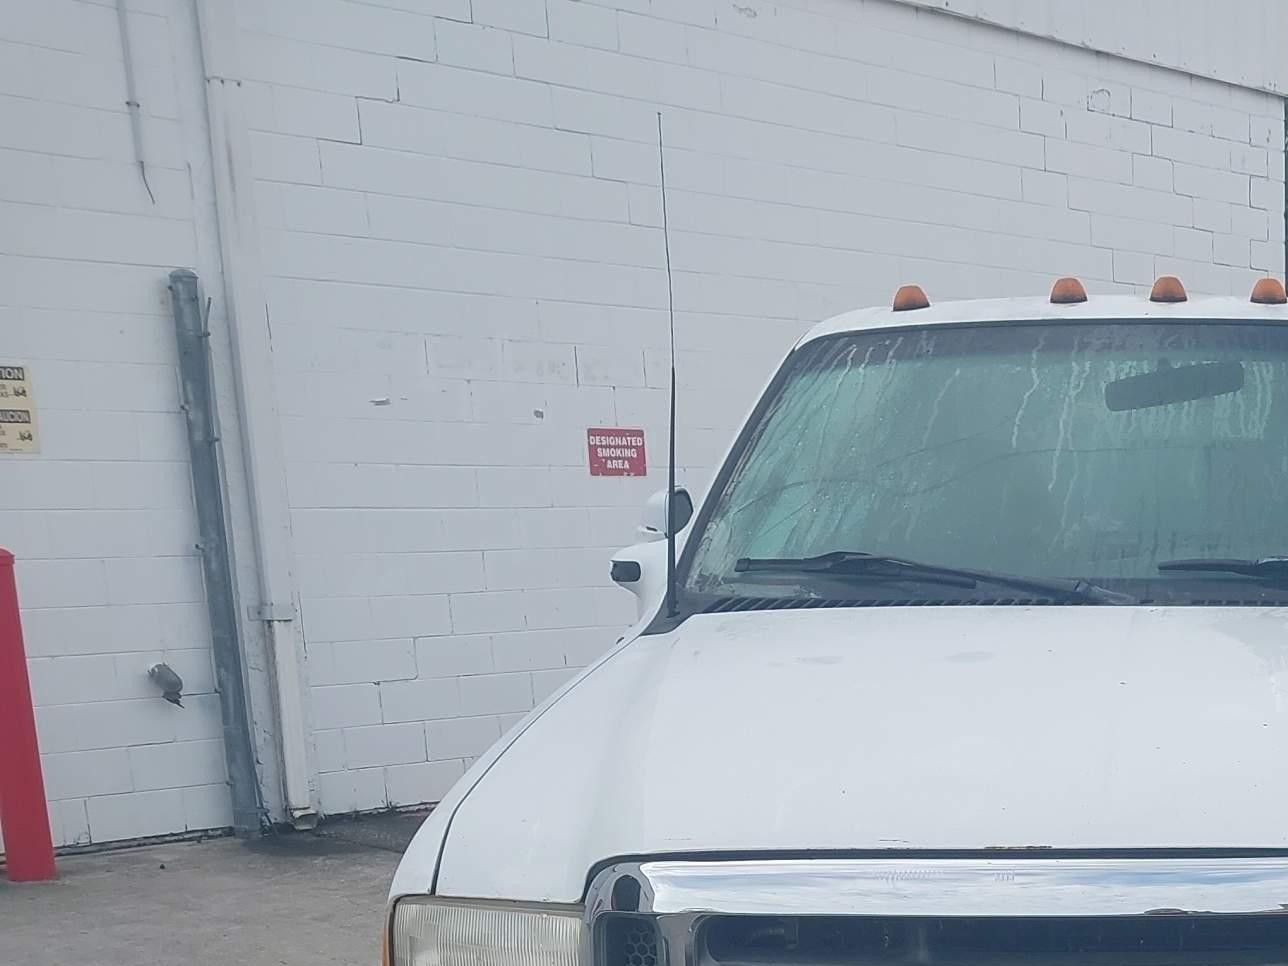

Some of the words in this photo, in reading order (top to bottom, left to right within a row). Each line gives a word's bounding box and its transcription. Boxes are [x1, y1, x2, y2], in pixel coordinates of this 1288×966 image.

[589, 435, 643, 446] DESIGNATED
[597, 447, 637, 458] SMOKING
[607, 459, 630, 469] AREA
